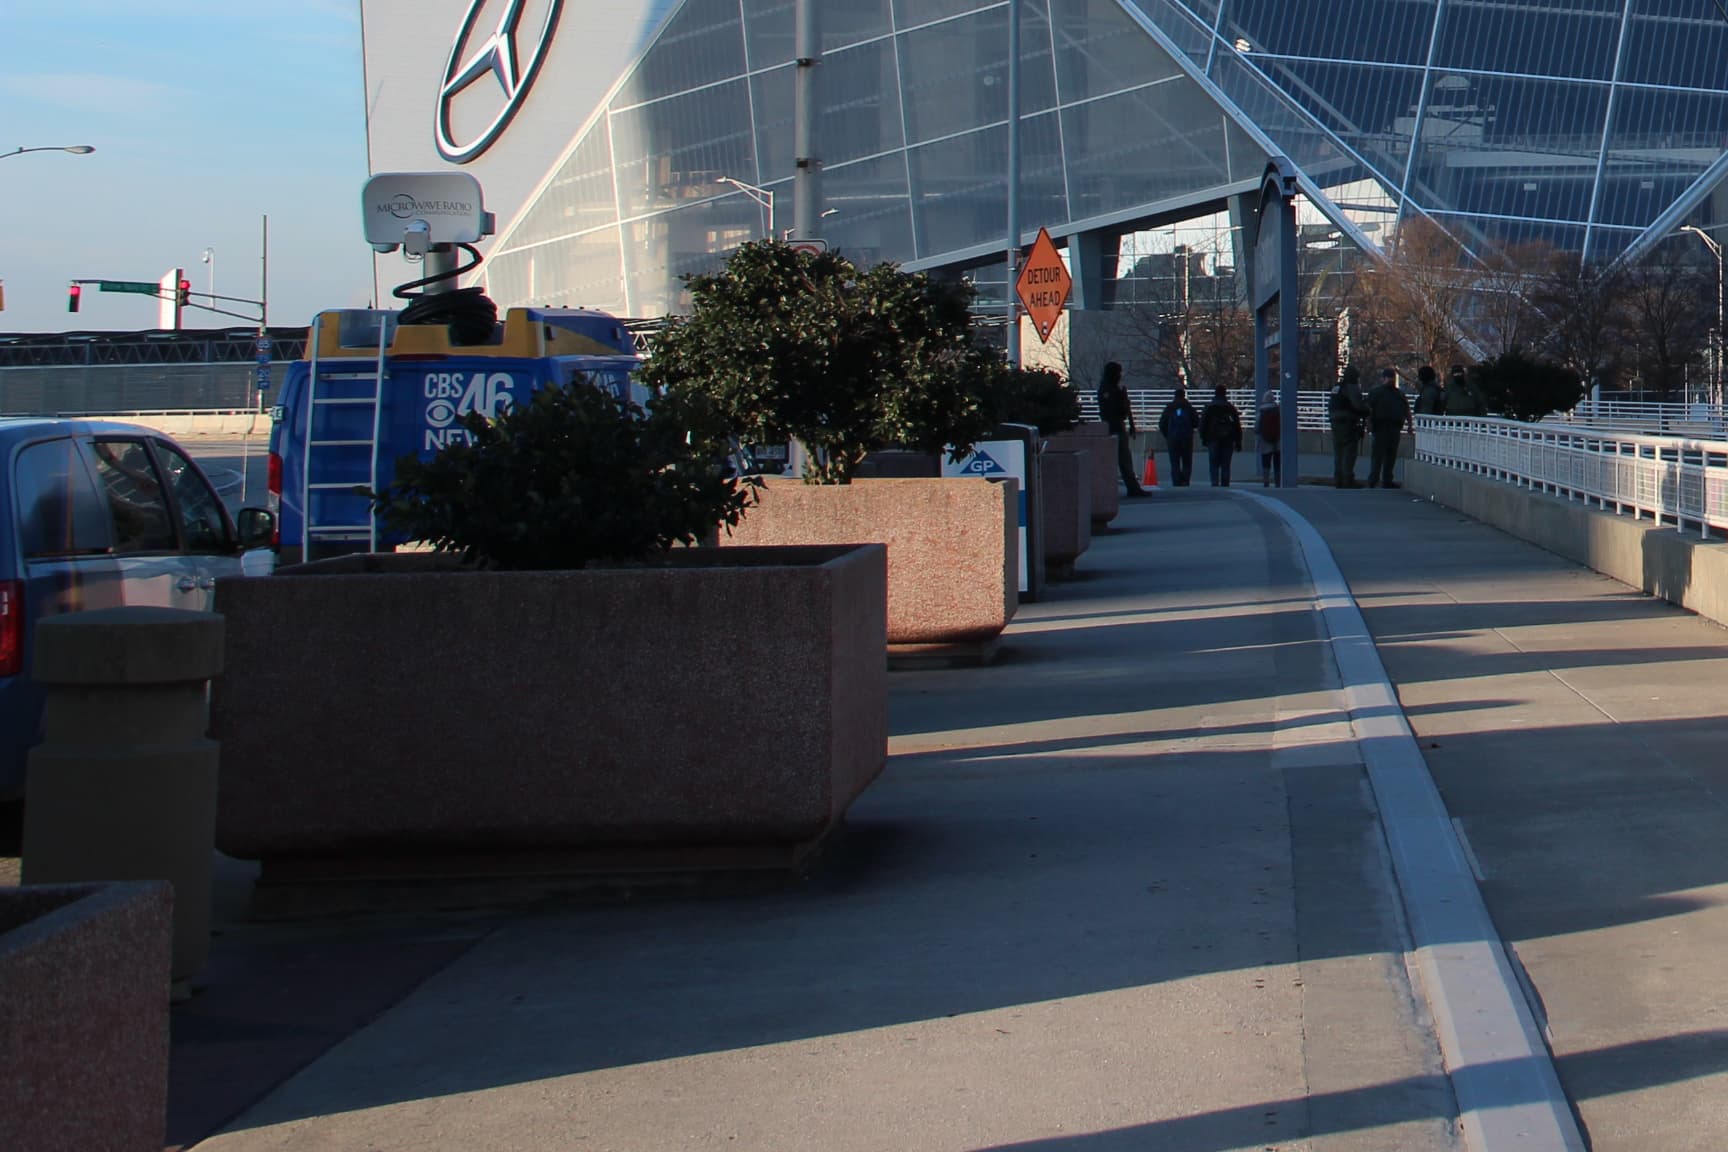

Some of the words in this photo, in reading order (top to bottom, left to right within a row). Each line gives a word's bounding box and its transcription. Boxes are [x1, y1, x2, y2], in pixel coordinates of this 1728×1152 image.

[377, 199, 441, 214] MICROWAVE
[443, 201, 473, 212] RADIO
[1027, 267, 1061, 285] DETOUR
[1030, 291, 1061, 307] AHEAD
[424, 372, 464, 399] CBS
[457, 372, 515, 417] 46
[970, 460, 995, 473] GP
